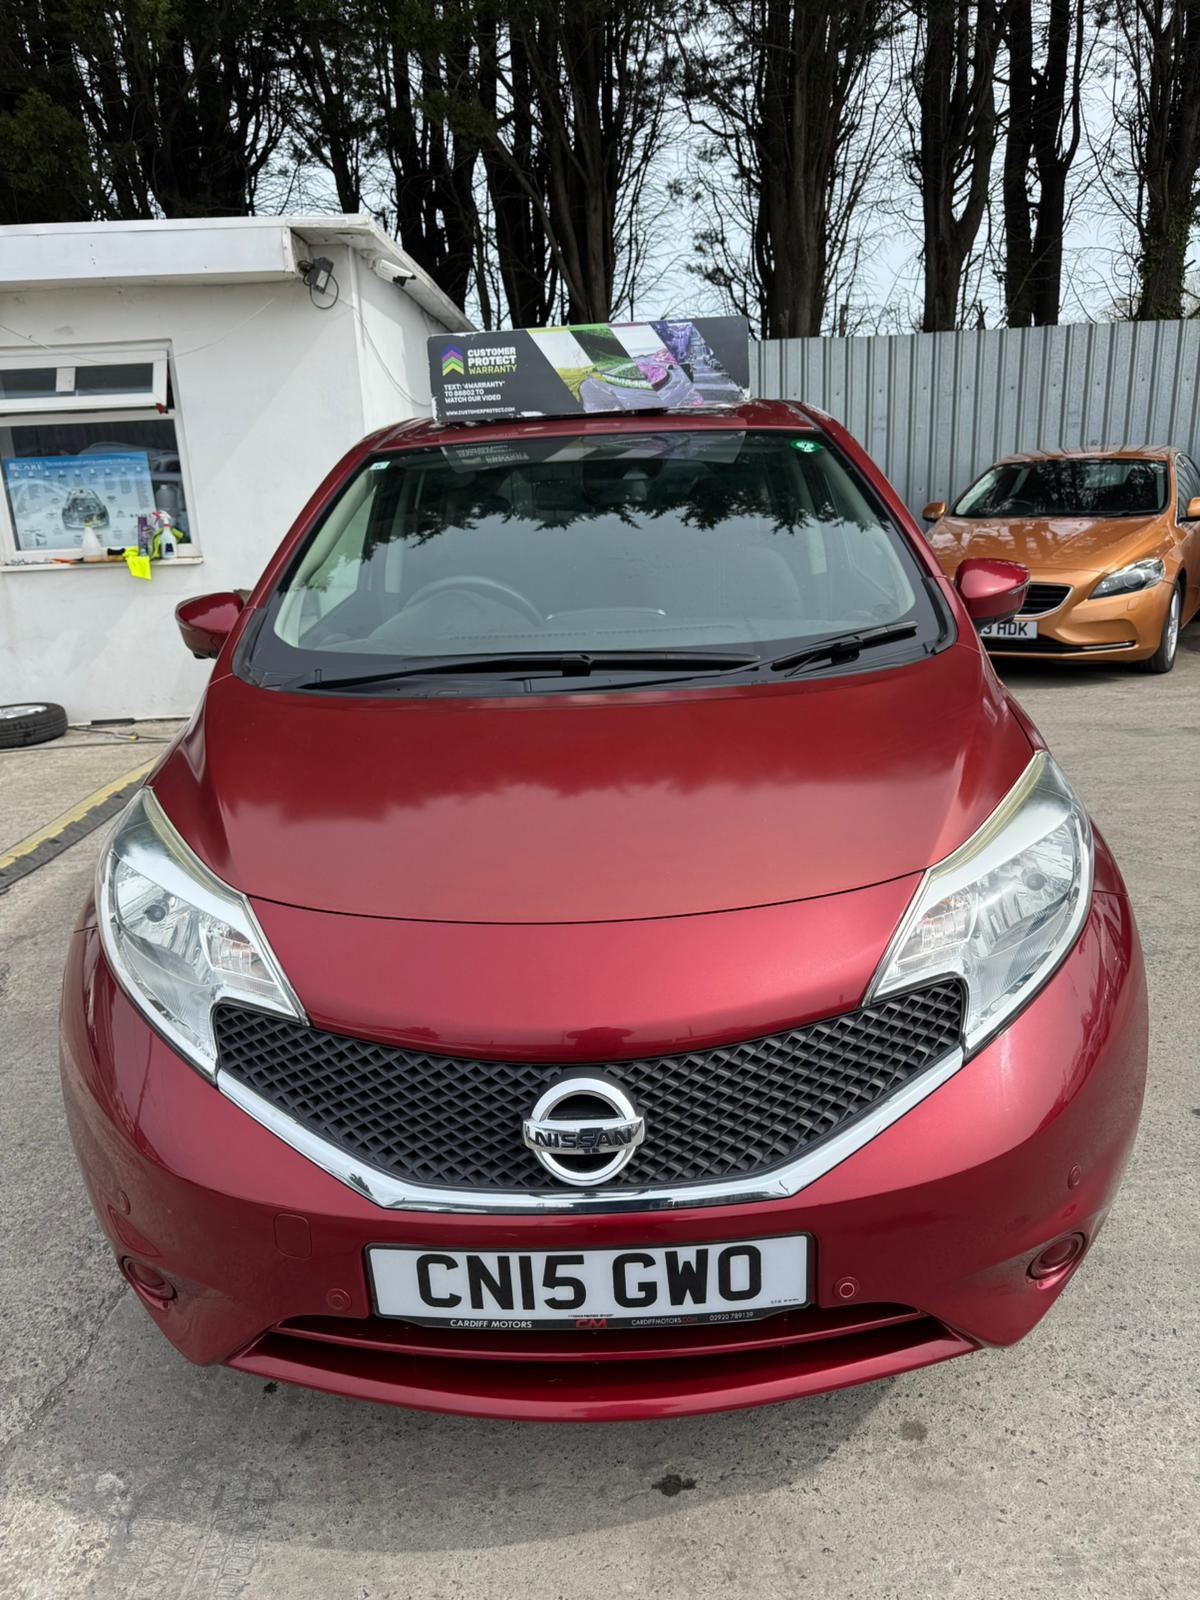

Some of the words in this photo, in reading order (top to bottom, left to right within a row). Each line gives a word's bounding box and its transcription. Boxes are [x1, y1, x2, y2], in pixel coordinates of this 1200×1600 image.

[467, 347, 516, 357] CUSTOMER
[468, 355, 517, 367] PROTECT
[469, 364, 517, 375] WARRANTY
[445, 396, 466, 404] WATCH
[996, 622, 1028, 636] HDK
[534, 1128, 632, 1148] NISSAN
[416, 1254, 586, 1310] CN15
[612, 1245, 761, 1306] GWO
[450, 1319, 488, 1328] CARDIFF
[491, 1320, 532, 1329] MOTORS
